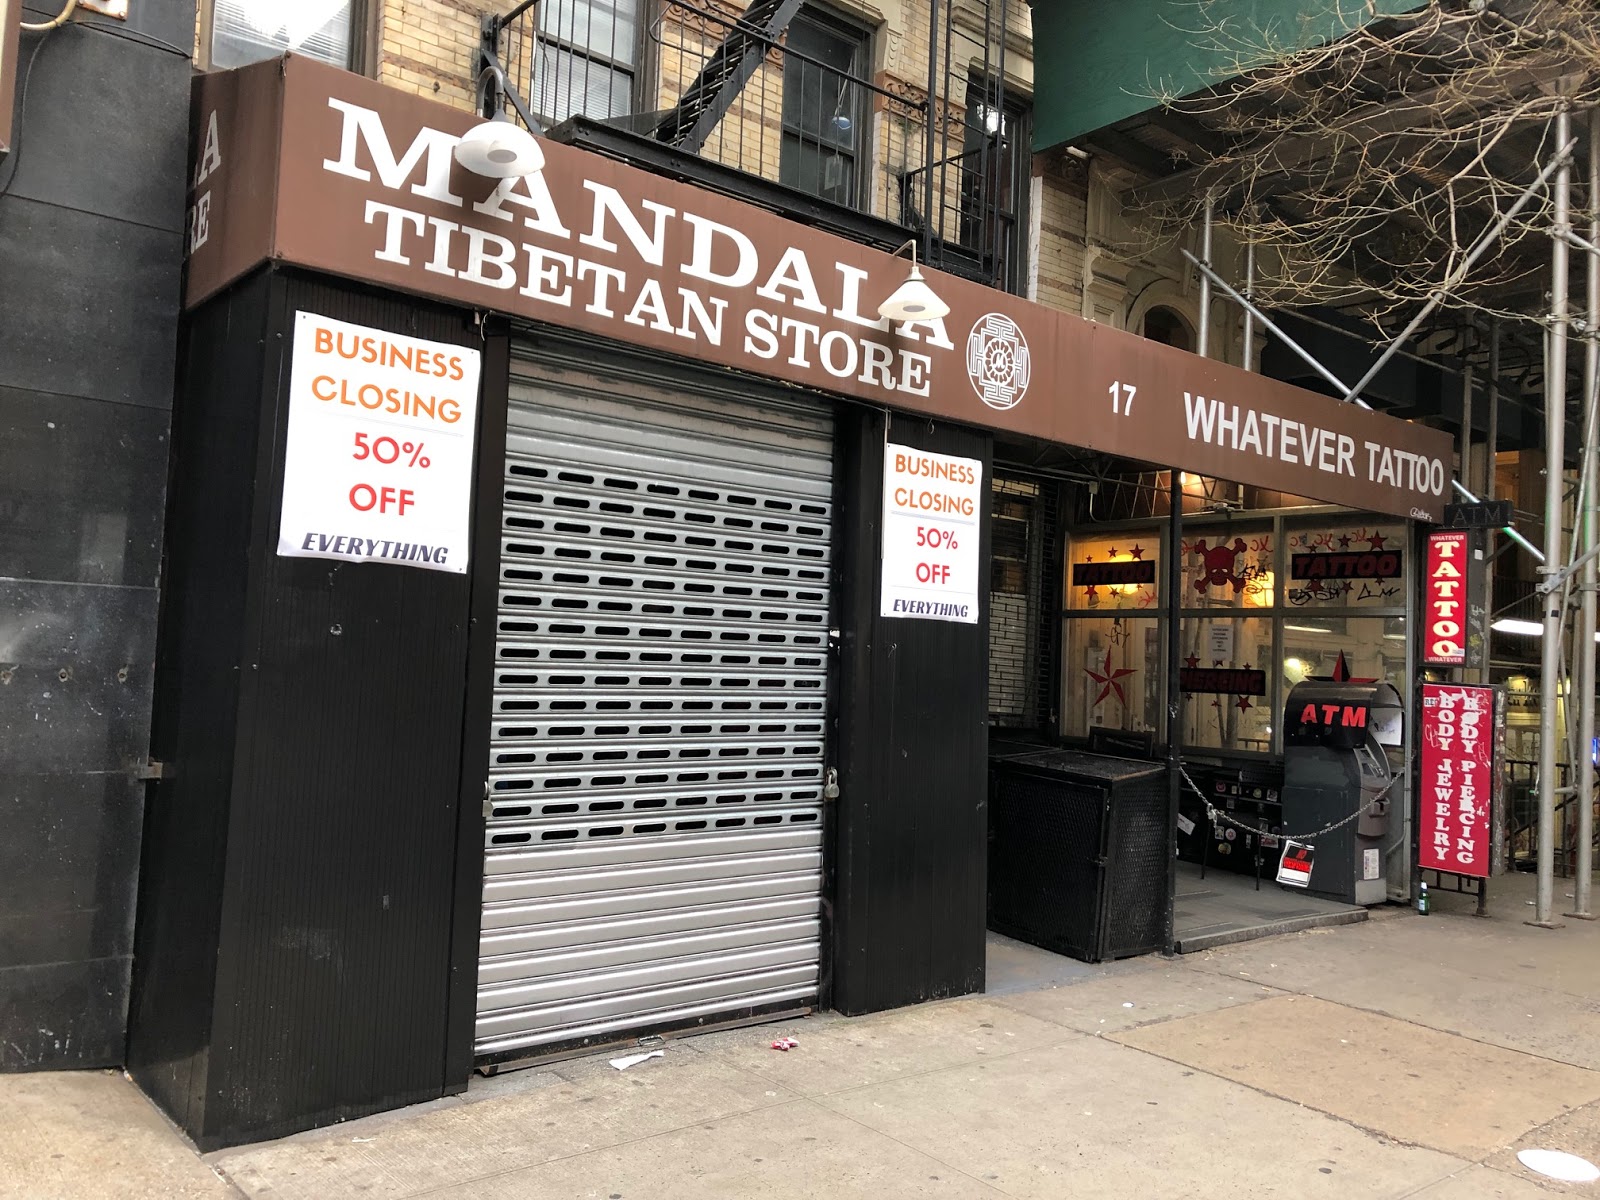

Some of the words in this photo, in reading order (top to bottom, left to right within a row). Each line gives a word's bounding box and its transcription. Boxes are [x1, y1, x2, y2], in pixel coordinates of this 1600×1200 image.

[364, 200, 729, 346] TIBETAN
[744, 308, 931, 397] STORE
[314, 328, 464, 381] BUSINESS
[311, 375, 462, 424] CLOSING
[1108, 381, 1137, 416] 17
[352, 432, 431, 469] 50%
[1184, 392, 1356, 477] WHATEVER
[1365, 441, 1445, 496] TATTOO
[895, 453, 975, 485] BUSINESS
[349, 483, 415, 516] OFF
[894, 487, 974, 516] CLOSING
[1452, 504, 1501, 526] ATM
[301, 532, 449, 564] EVERYTHING
[916, 526, 958, 549] 50%
[1429, 534, 1465, 542] WHATEVER
[915, 562, 951, 584] OFF
[1294, 554, 1399, 578] TATTOO
[893, 599, 968, 618] EVERYTHING
[1431, 541, 1461, 657] TATTOO
[1300, 703, 1367, 728] ATM
[1438, 694, 1456, 751] BODY
[1433, 758, 1454, 860] JEWELRY
